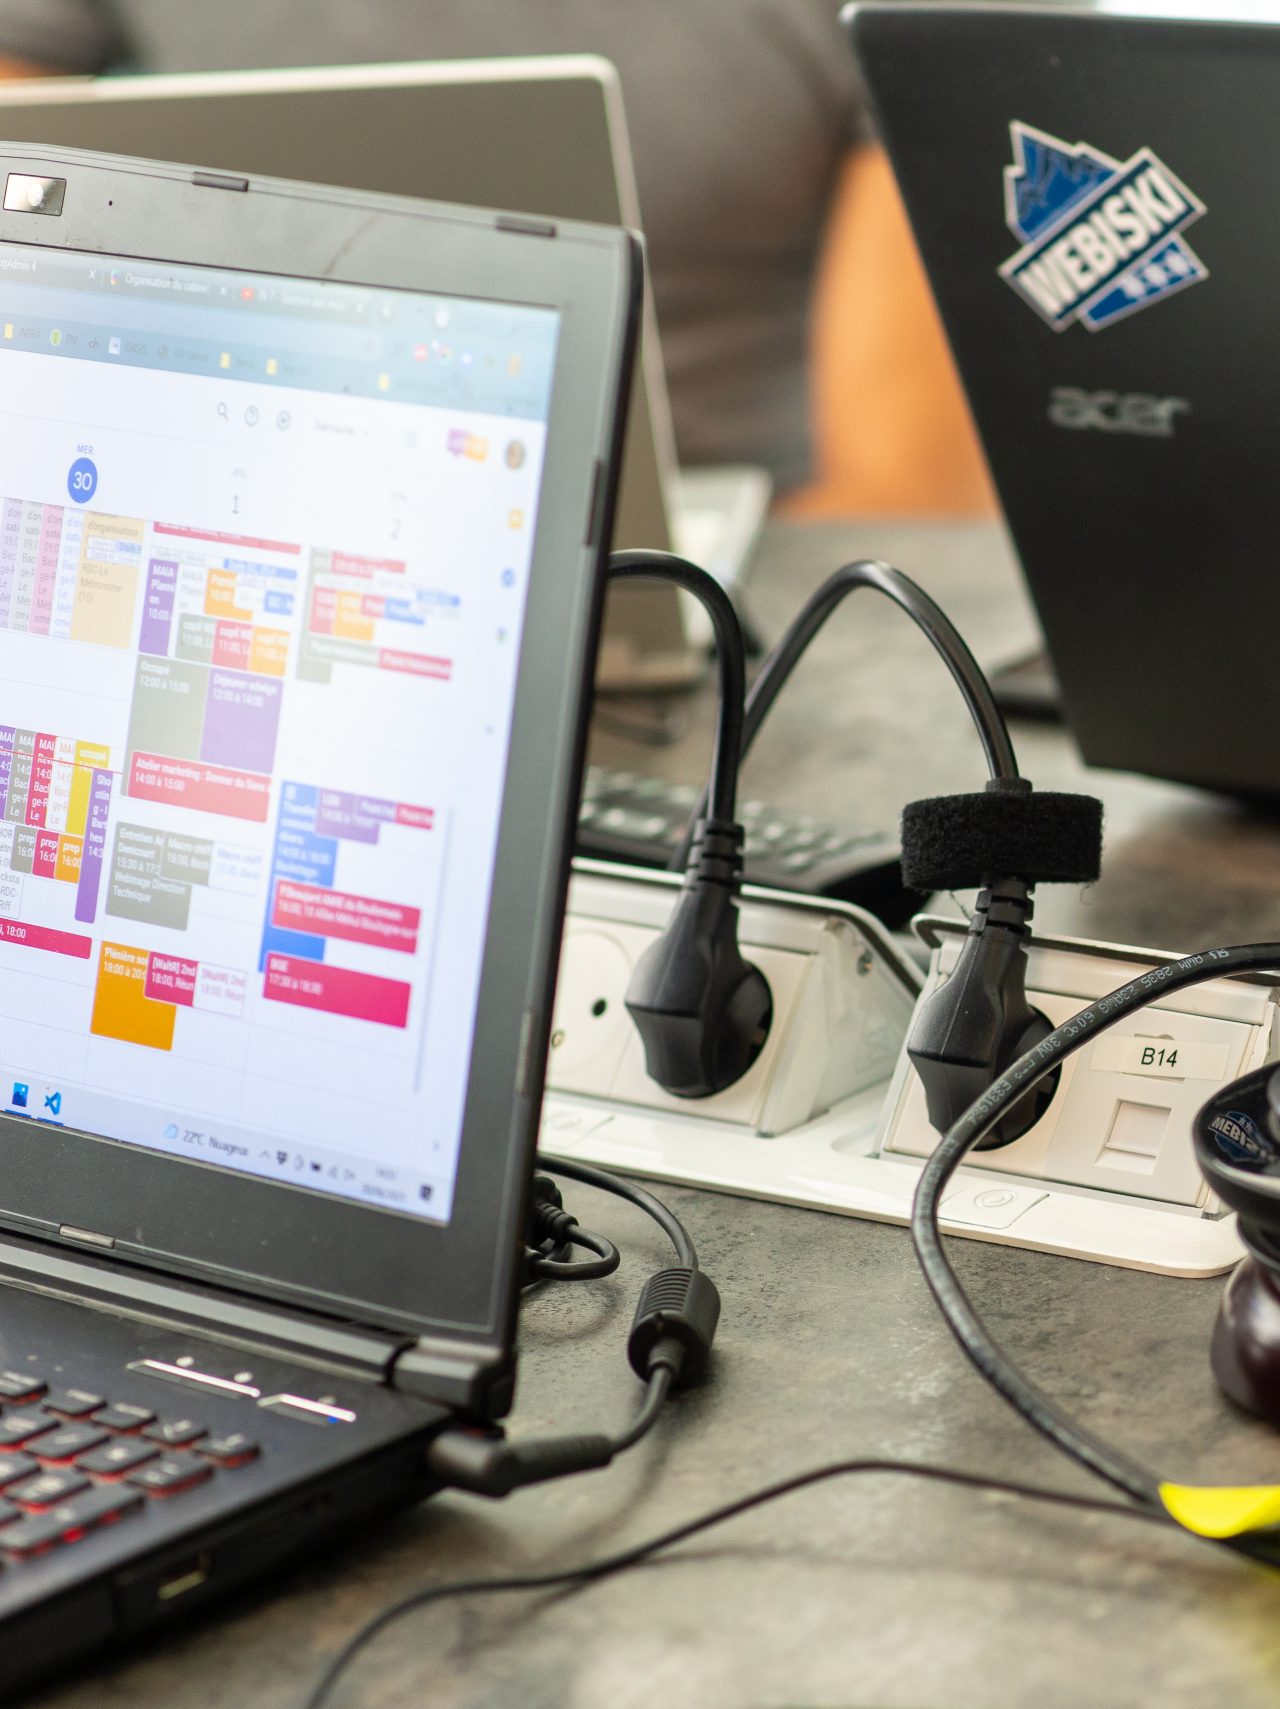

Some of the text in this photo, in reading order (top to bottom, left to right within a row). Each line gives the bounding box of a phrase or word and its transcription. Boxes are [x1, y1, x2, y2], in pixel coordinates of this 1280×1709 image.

[1016, 167, 1187, 314] WEBISKI
[1048, 386, 1192, 437] acer
[77, 444, 96, 456] MER.
[73, 471, 92, 491] 30
[231, 494, 240, 515] 1
[136, 758, 161, 773] Atelier
[96, 774, 111, 786] Sho
[134, 772, 155, 786] 14:00
[10, 805, 20, 816] Le
[30, 809, 40, 821] Le
[18, 833, 35, 846] prep
[40, 837, 57, 850] prep
[62, 841, 80, 855] prep
[113, 884, 152, 904] Technique
[6, 924, 26, 939] 18:00
[104, 946, 136, 963] Plénière
[103, 961, 124, 976] 18:00
[1177, 954, 1204, 971] AWM
[181, 963, 196, 978] 2nd
[1140, 965, 1174, 989] 2835
[1037, 1036, 1062, 1058] 30V
[1140, 1046, 1178, 1068] B14
[208, 1136, 249, 1157] Nuageux
